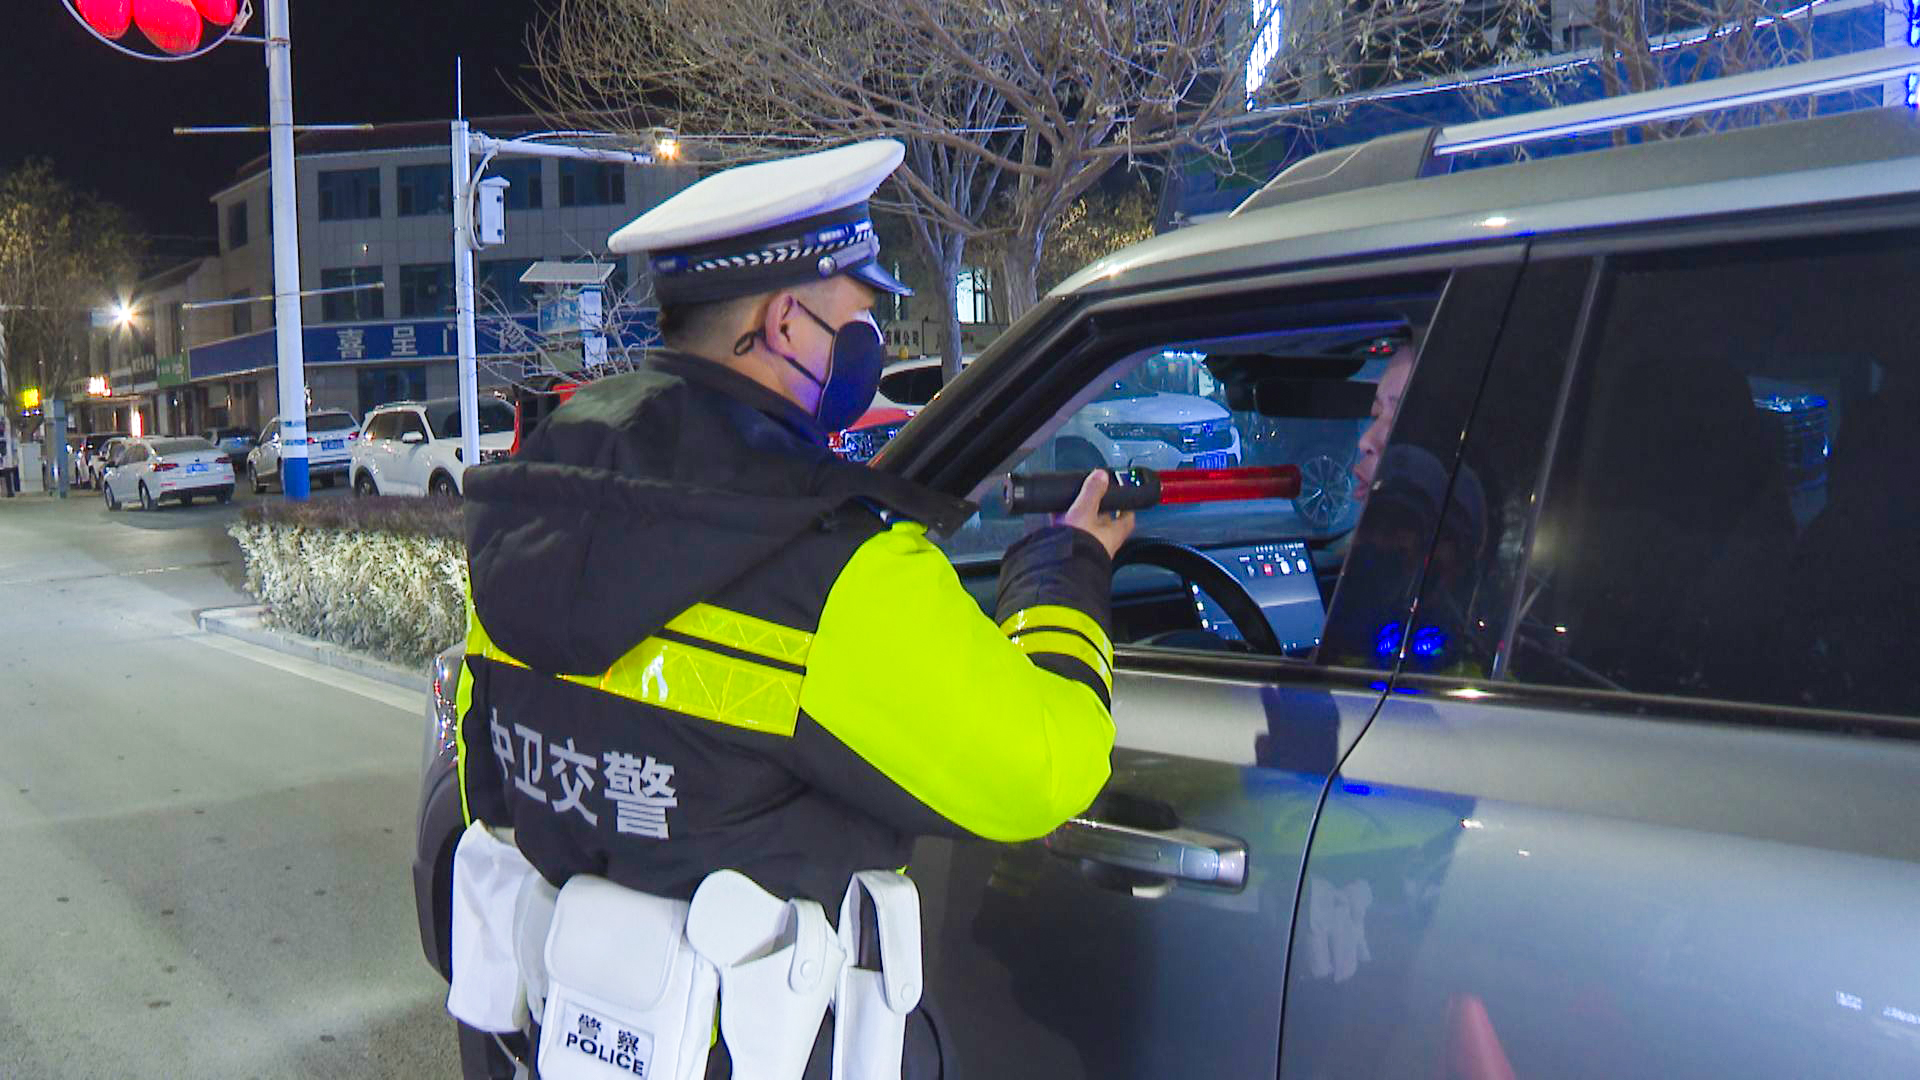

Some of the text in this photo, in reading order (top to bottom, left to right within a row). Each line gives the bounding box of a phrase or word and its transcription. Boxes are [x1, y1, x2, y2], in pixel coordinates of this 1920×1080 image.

[490, 707, 678, 839] 中卫交警
[566, 1032, 645, 1076] POLICE
[578, 1013, 640, 1056] 警察
